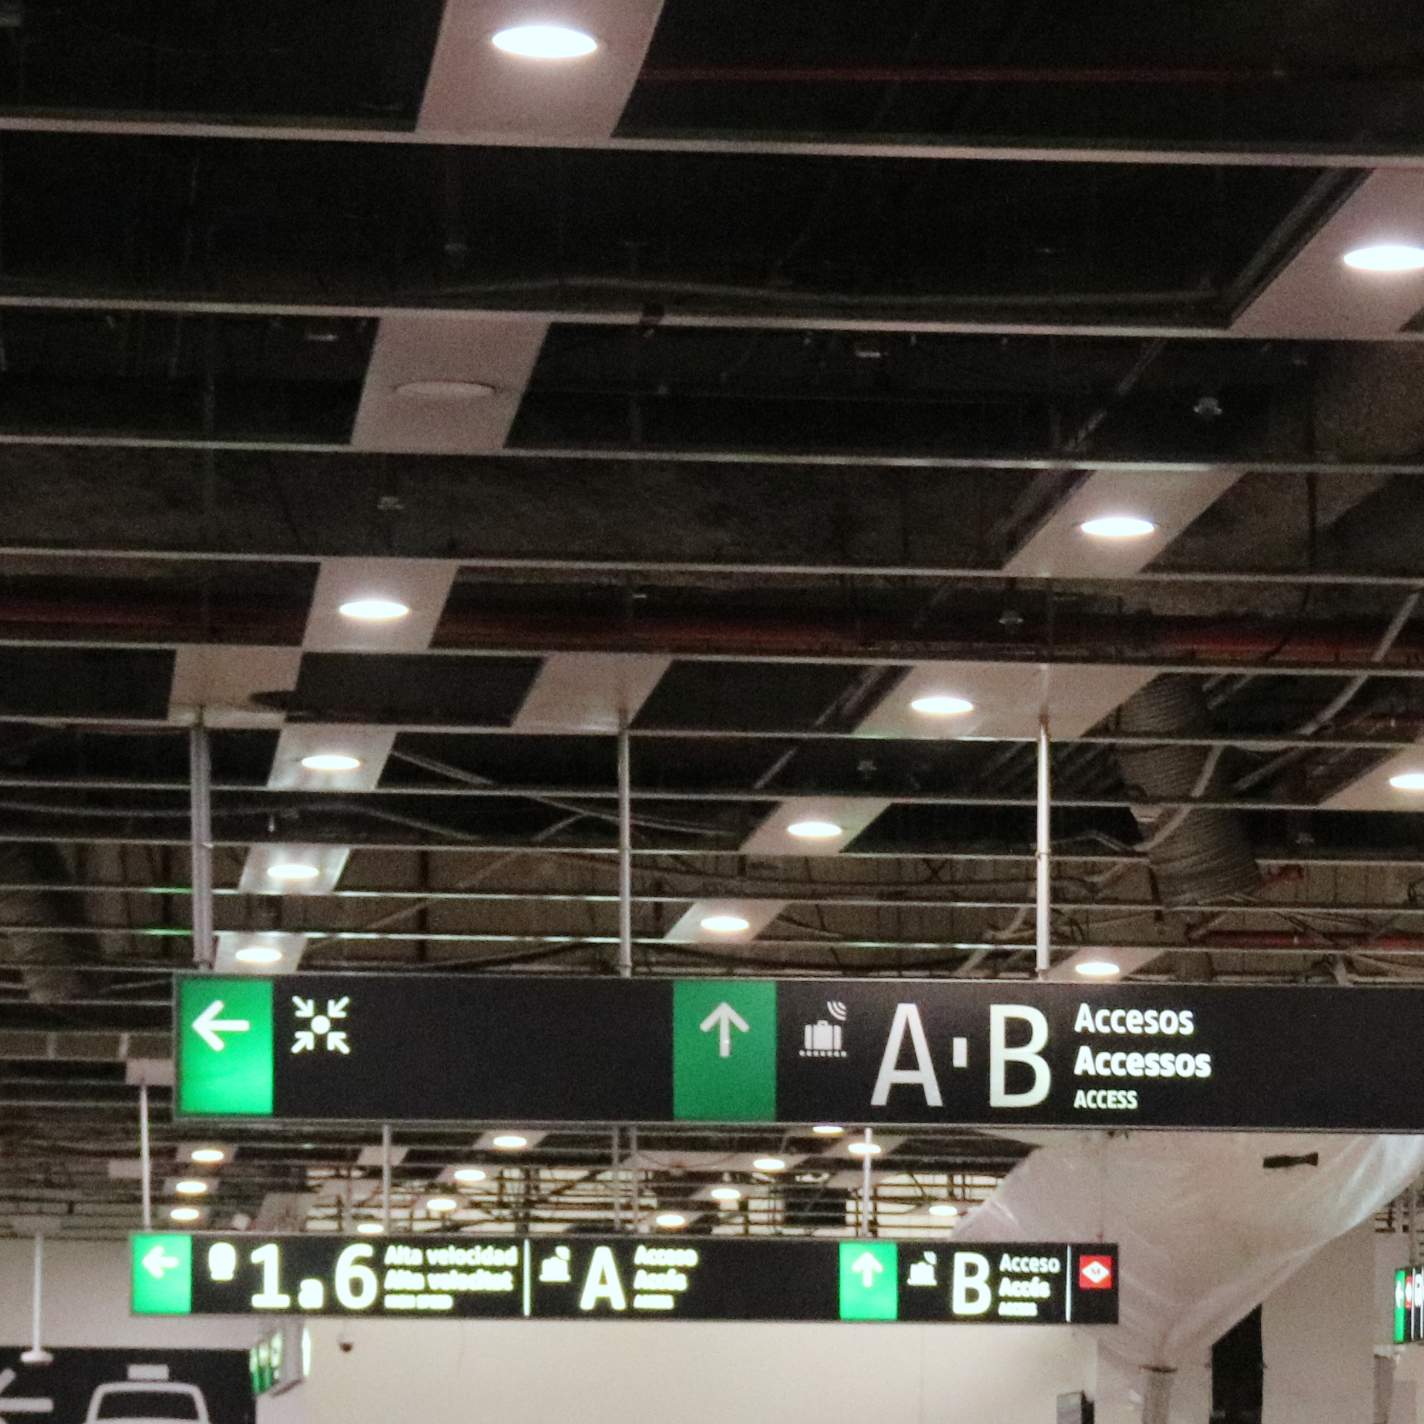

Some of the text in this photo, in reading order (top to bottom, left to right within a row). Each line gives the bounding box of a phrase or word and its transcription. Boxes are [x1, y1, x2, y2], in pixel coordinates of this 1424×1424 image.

[1074, 1003, 1194, 1035] Accesos
[1074, 1046, 1212, 1078] Accessos
[1073, 1089, 1138, 1109] ACCESS
[580, 1246, 626, 1310] A
[999, 1253, 1061, 1273] Acceso
[951, 1251, 992, 1315] B
